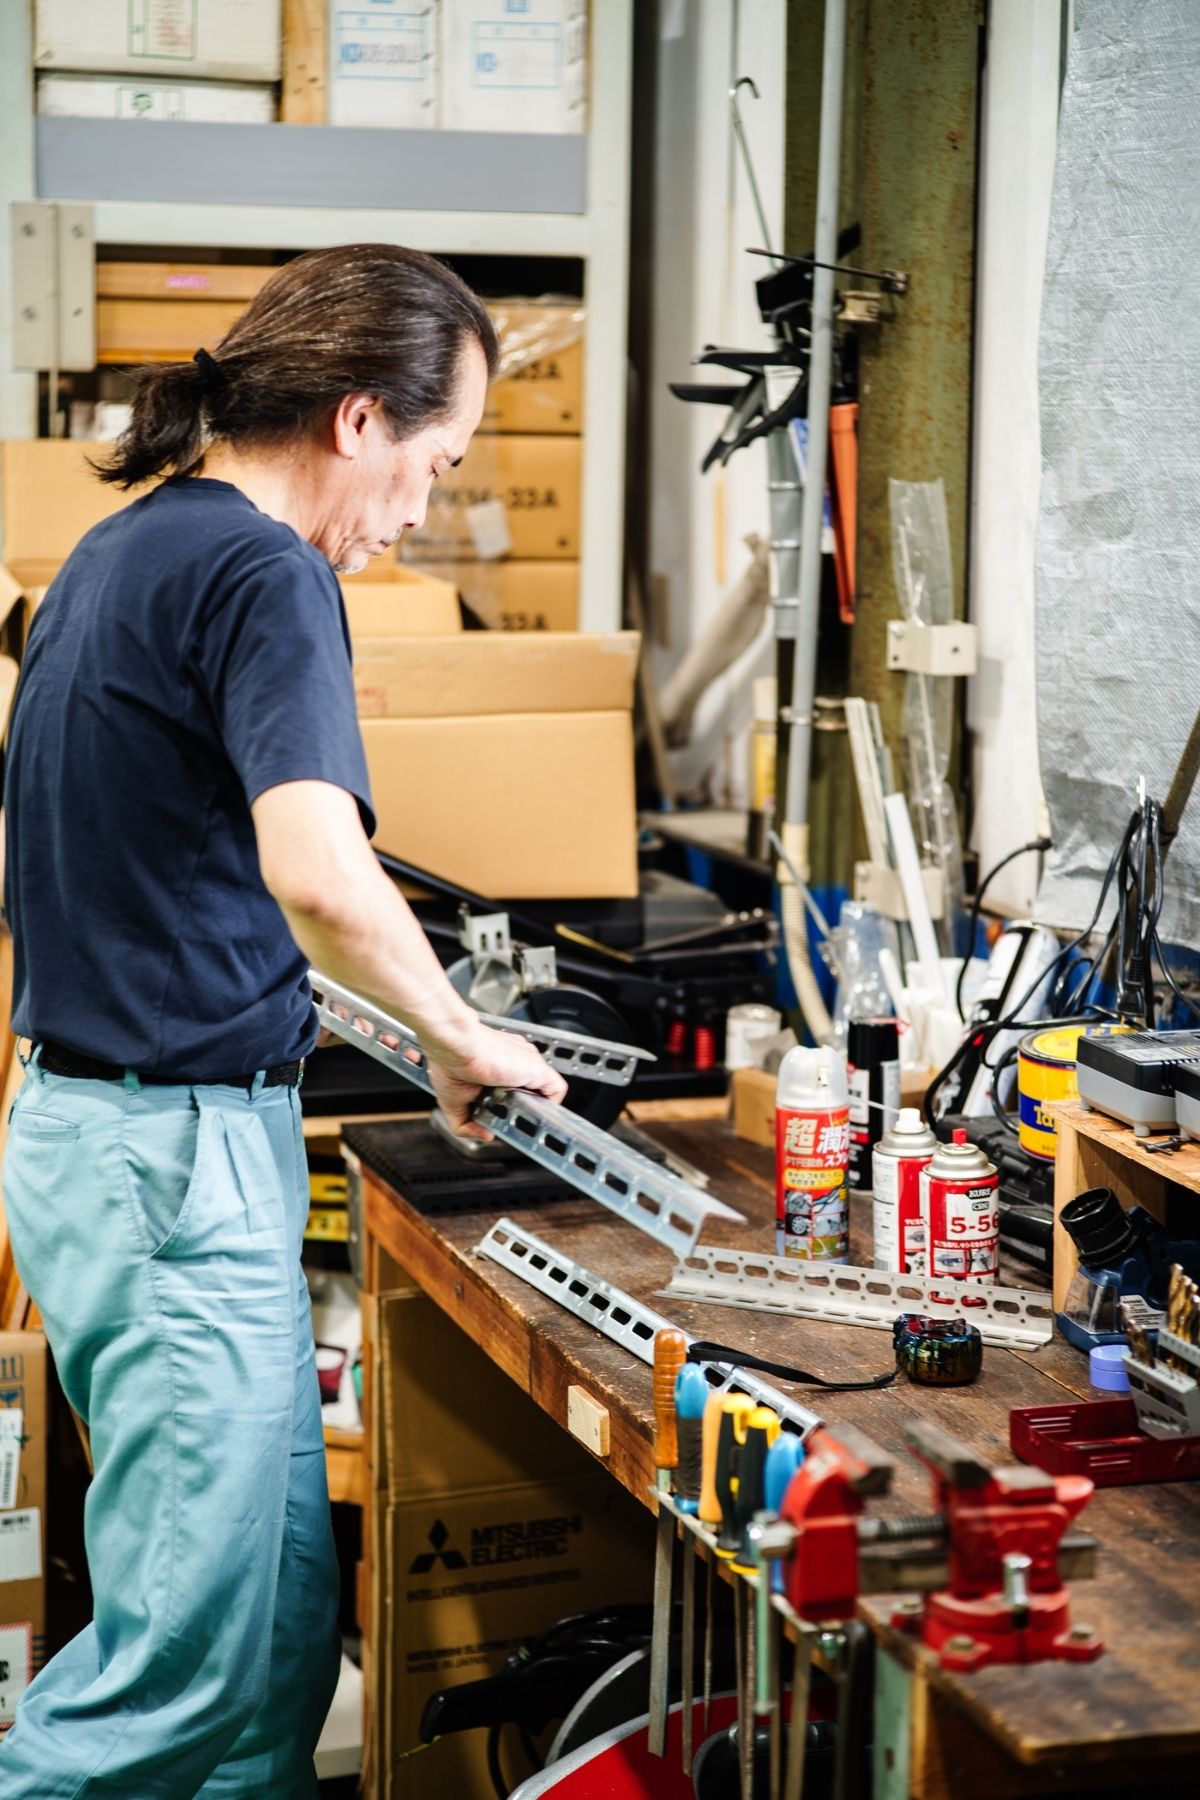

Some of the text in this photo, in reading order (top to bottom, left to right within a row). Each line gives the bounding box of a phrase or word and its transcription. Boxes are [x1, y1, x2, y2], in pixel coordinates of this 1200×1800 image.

[1034, 1104, 1056, 1130] Ta
[968, 1187, 992, 1199] KURE
[951, 1211, 1000, 1234] 5-56
[471, 1515, 583, 1546] MITSUBISHI
[471, 1538, 569, 1566] ELECTRIC
